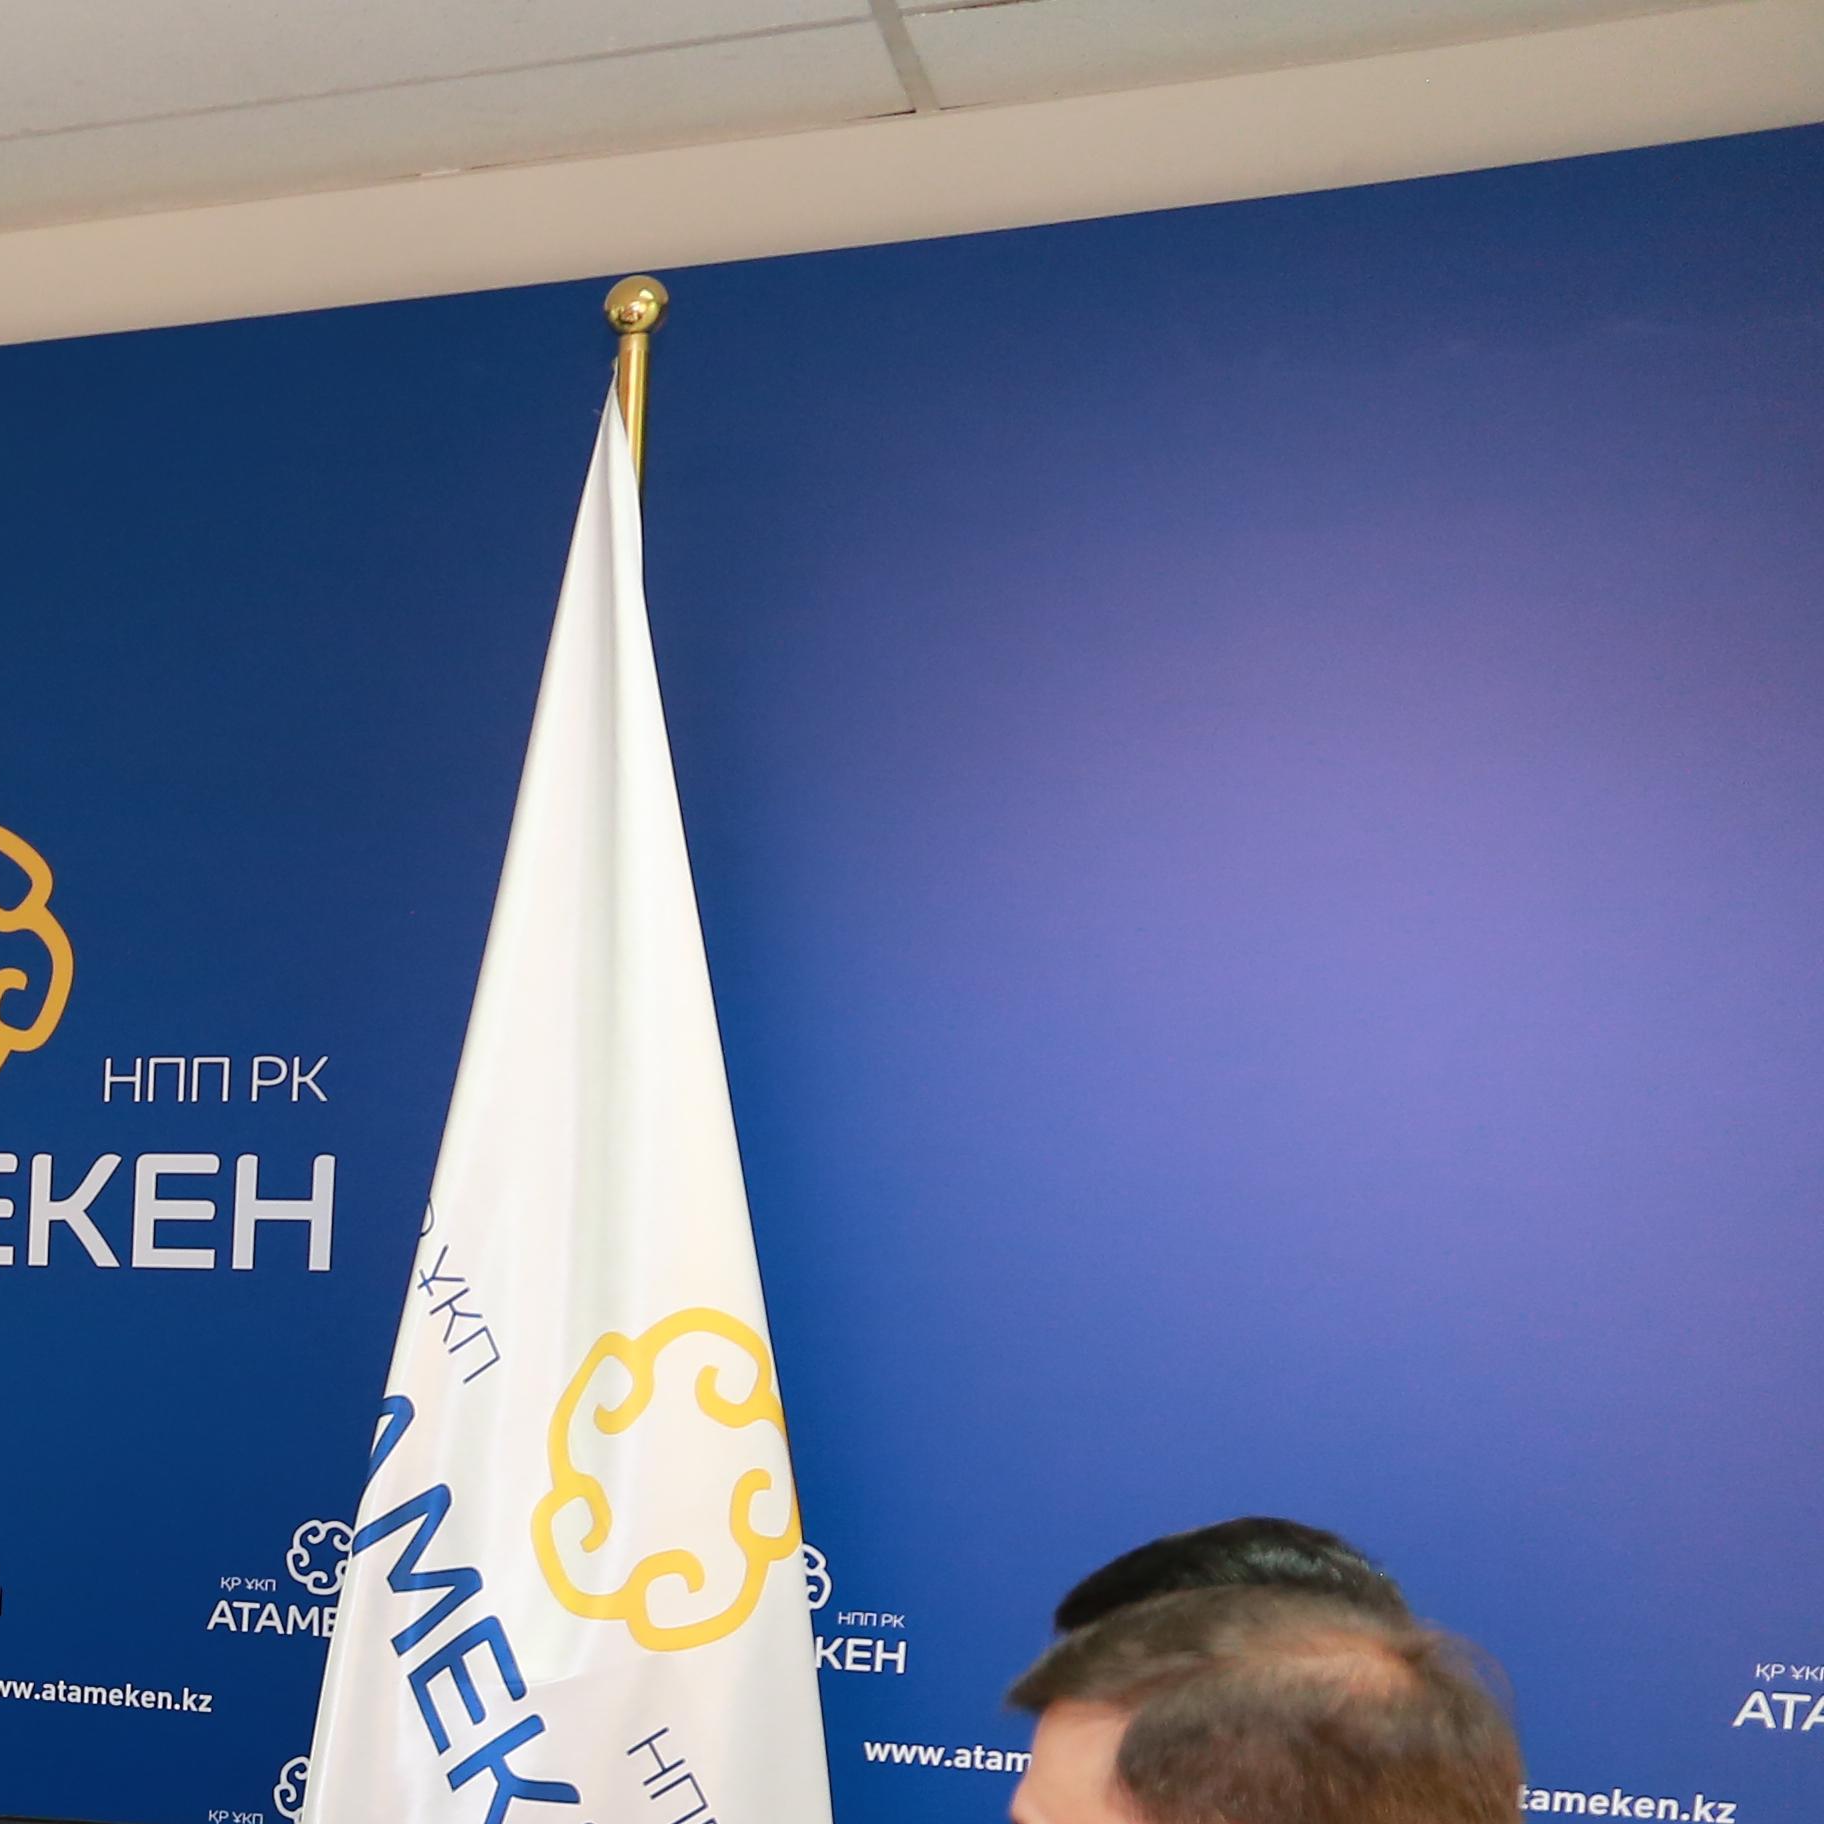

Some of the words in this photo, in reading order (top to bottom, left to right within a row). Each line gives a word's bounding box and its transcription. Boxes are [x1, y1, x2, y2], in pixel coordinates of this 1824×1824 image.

[101, 1056, 231, 1103] НПП
[250, 1056, 329, 1103] РК
[207, 1599, 338, 1638] АТАМЕ
[837, 1611, 877, 1627] НПП
[880, 1613, 906, 1629] РК
[863, 1740, 1034, 1774] www.atam
[1517, 1783, 1738, 1824] tameken.kz
